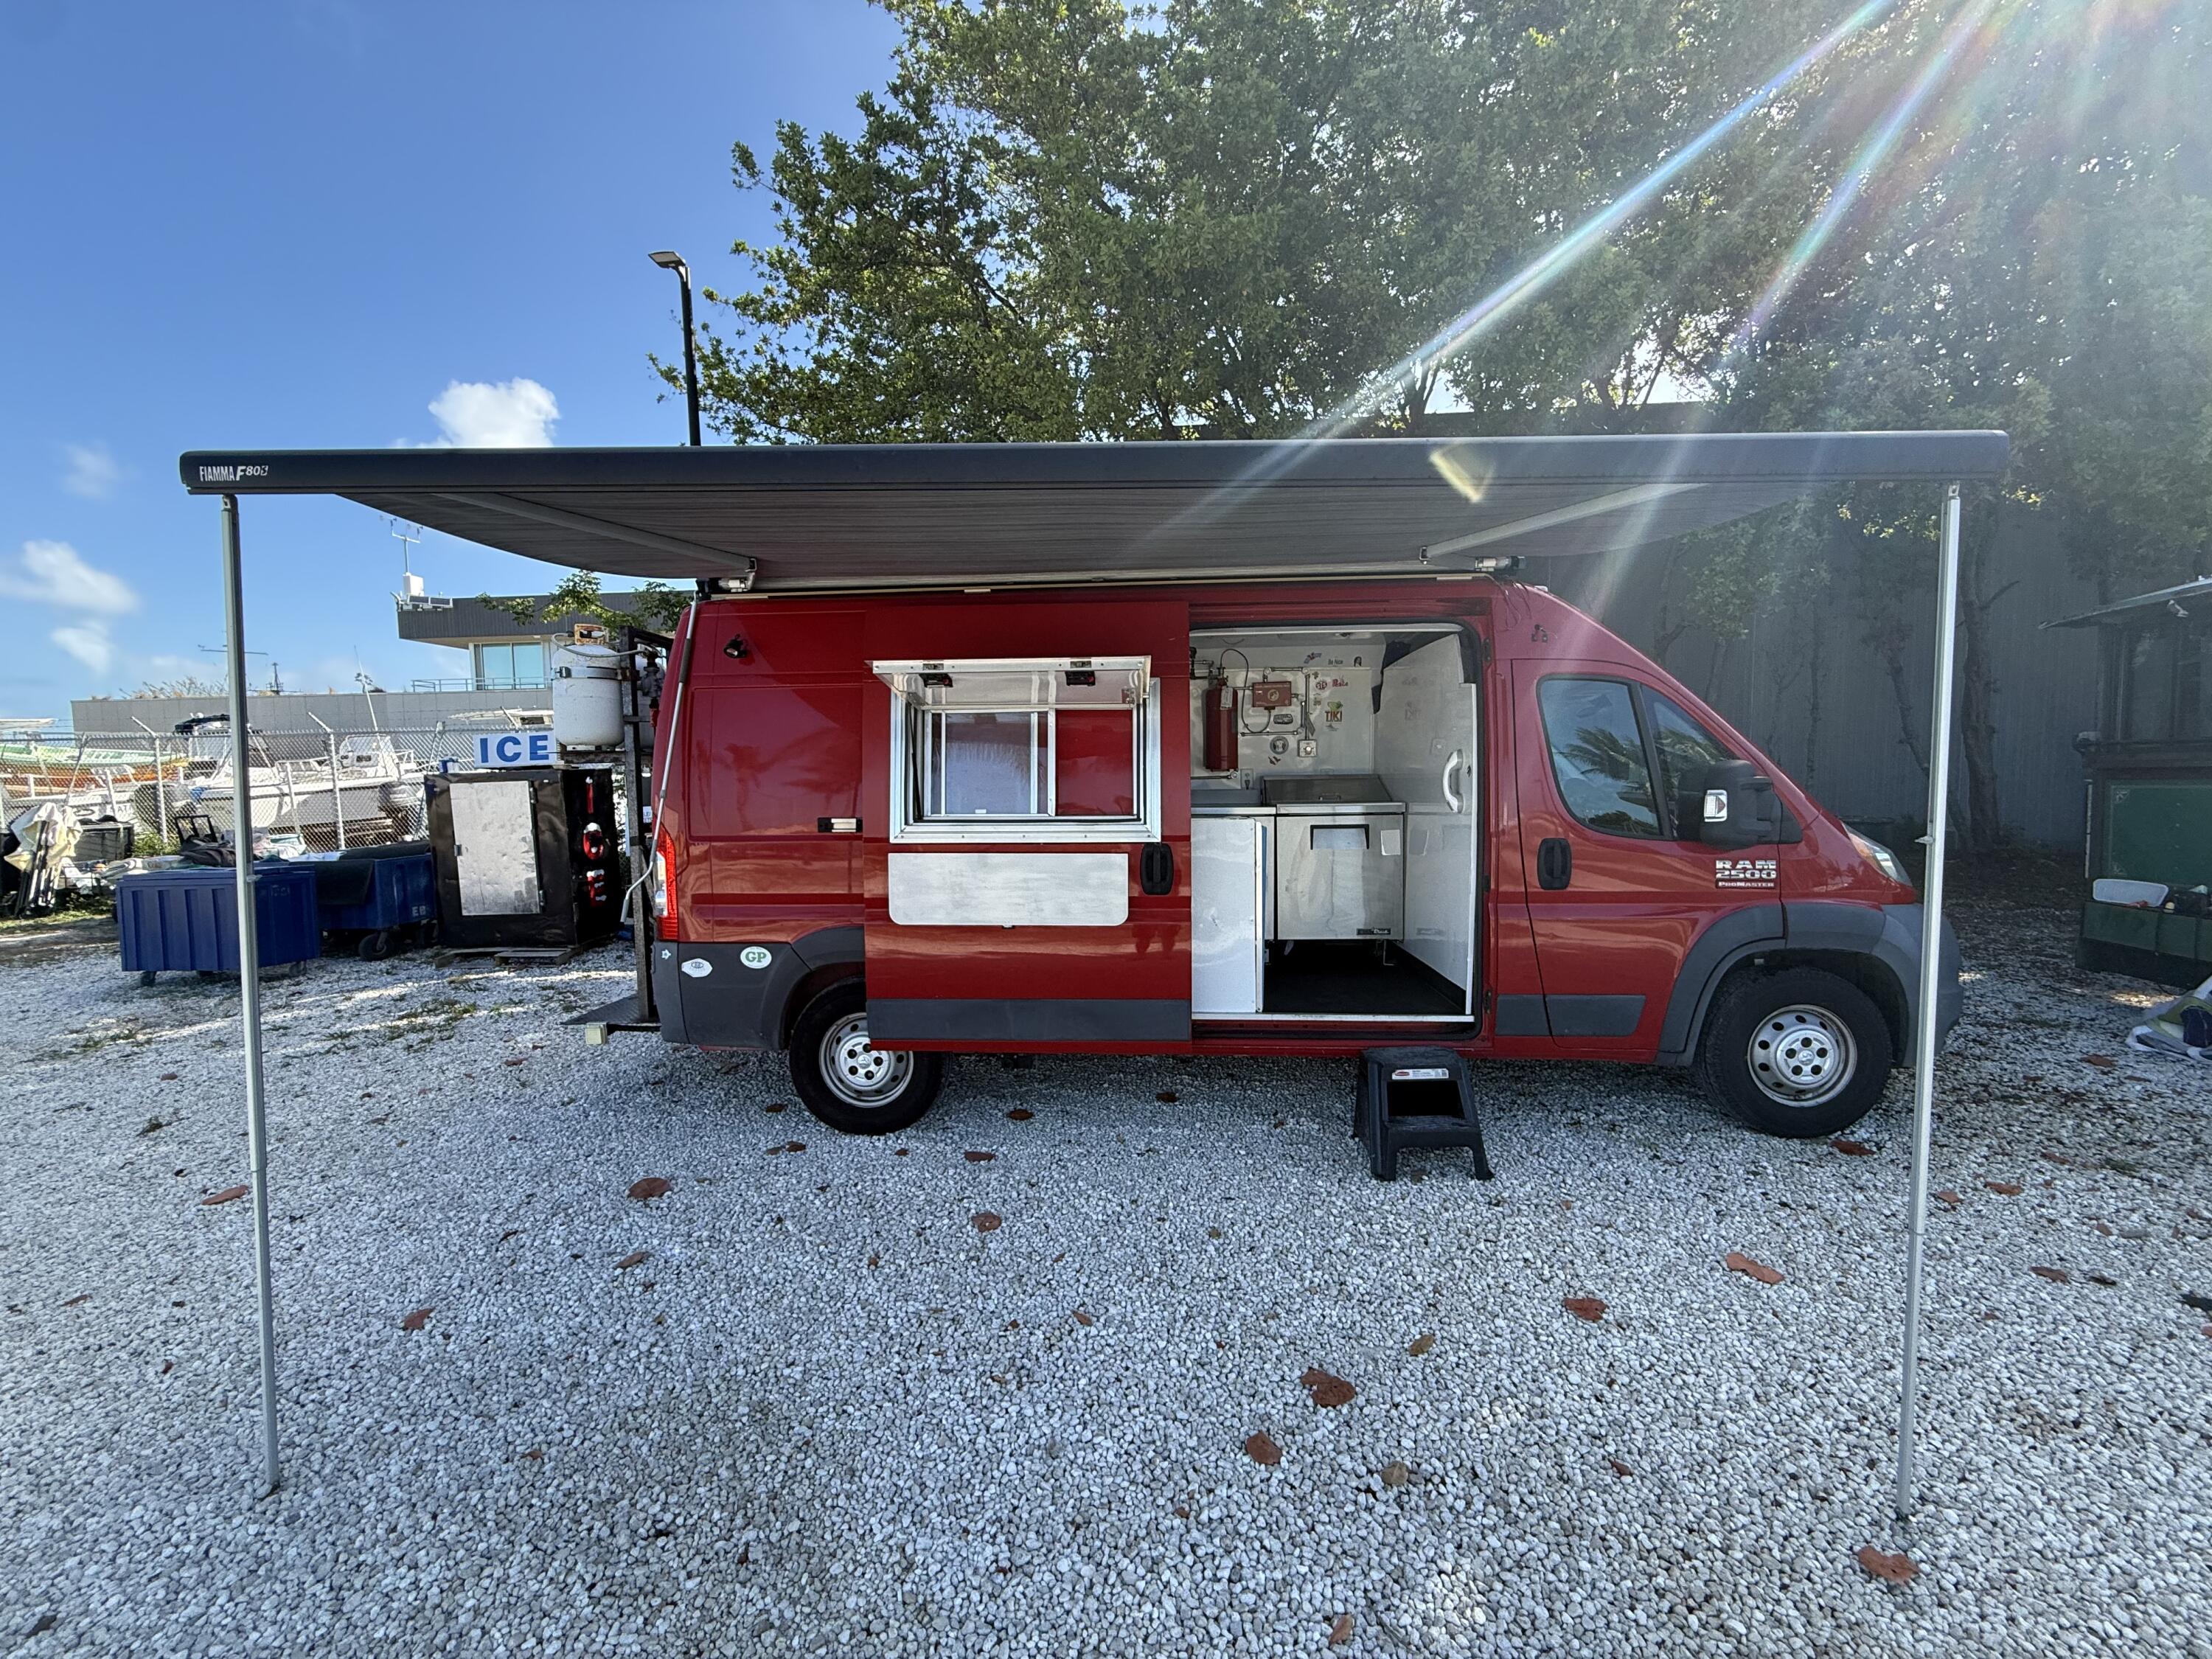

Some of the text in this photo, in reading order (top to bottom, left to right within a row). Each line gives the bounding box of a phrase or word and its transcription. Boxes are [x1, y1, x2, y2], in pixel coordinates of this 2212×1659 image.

[199, 465, 235, 481] FIAMMA
[1325, 711, 1343, 723] TIKI
[479, 734, 549, 764] ICE
[1716, 860, 1777, 869] RAM
[1716, 869, 1777, 879] 2500
[745, 951, 767, 963] GP
